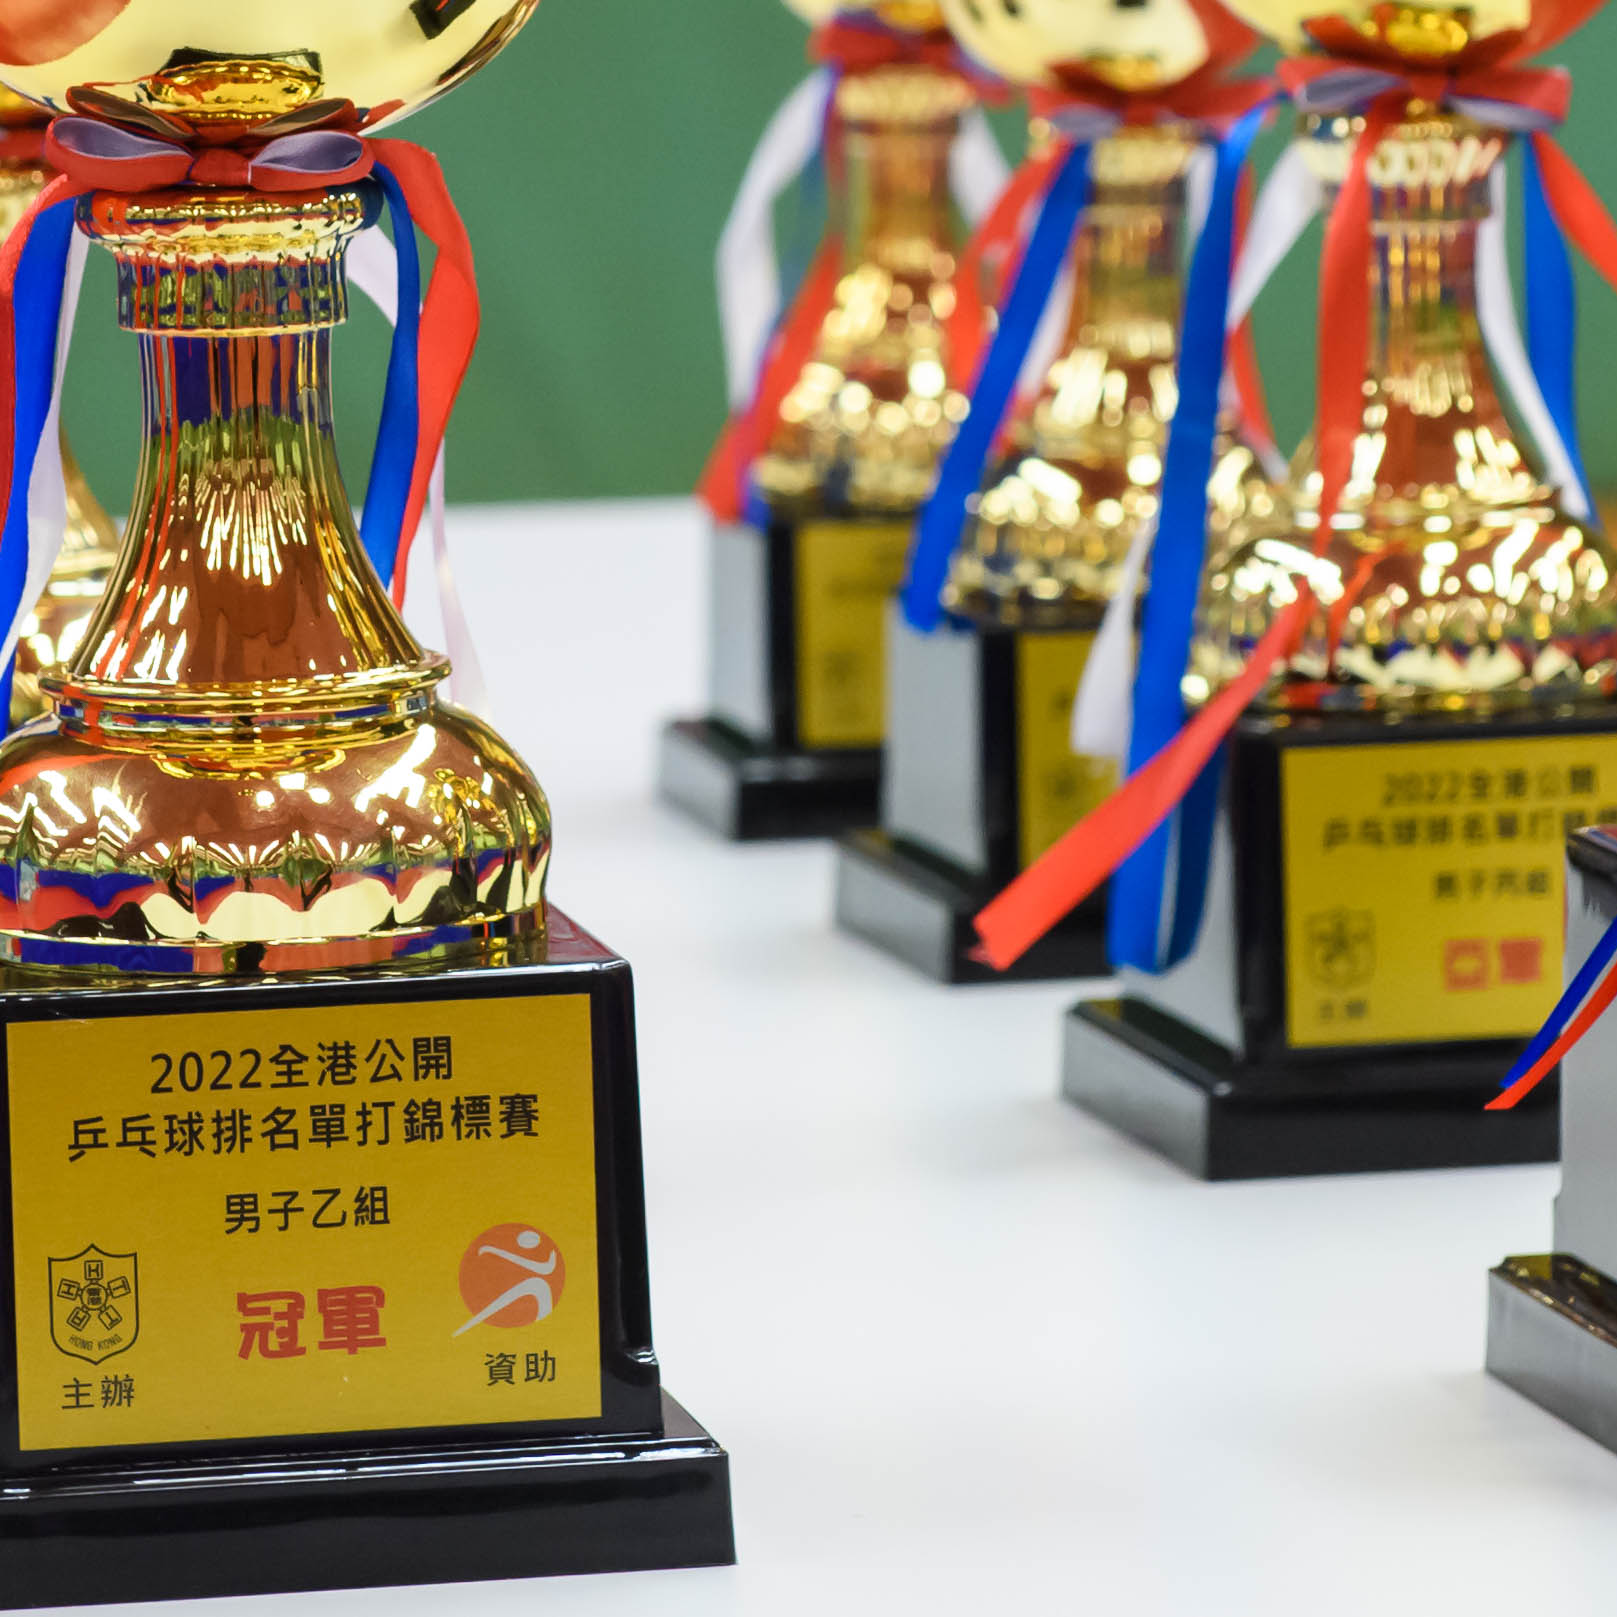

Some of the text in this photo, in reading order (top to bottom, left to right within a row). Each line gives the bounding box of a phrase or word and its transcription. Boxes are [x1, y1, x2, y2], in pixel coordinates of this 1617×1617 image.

[149, 1034, 454, 1095] 2022全港公開
[67, 1092, 541, 1163] 乒乓球排名單打錦標賽
[224, 1185, 392, 1235] 男子乙組
[235, 1284, 388, 1361] 冠軍
[61, 1373, 135, 1410] 主辦
[483, 1349, 557, 1387] 資助
